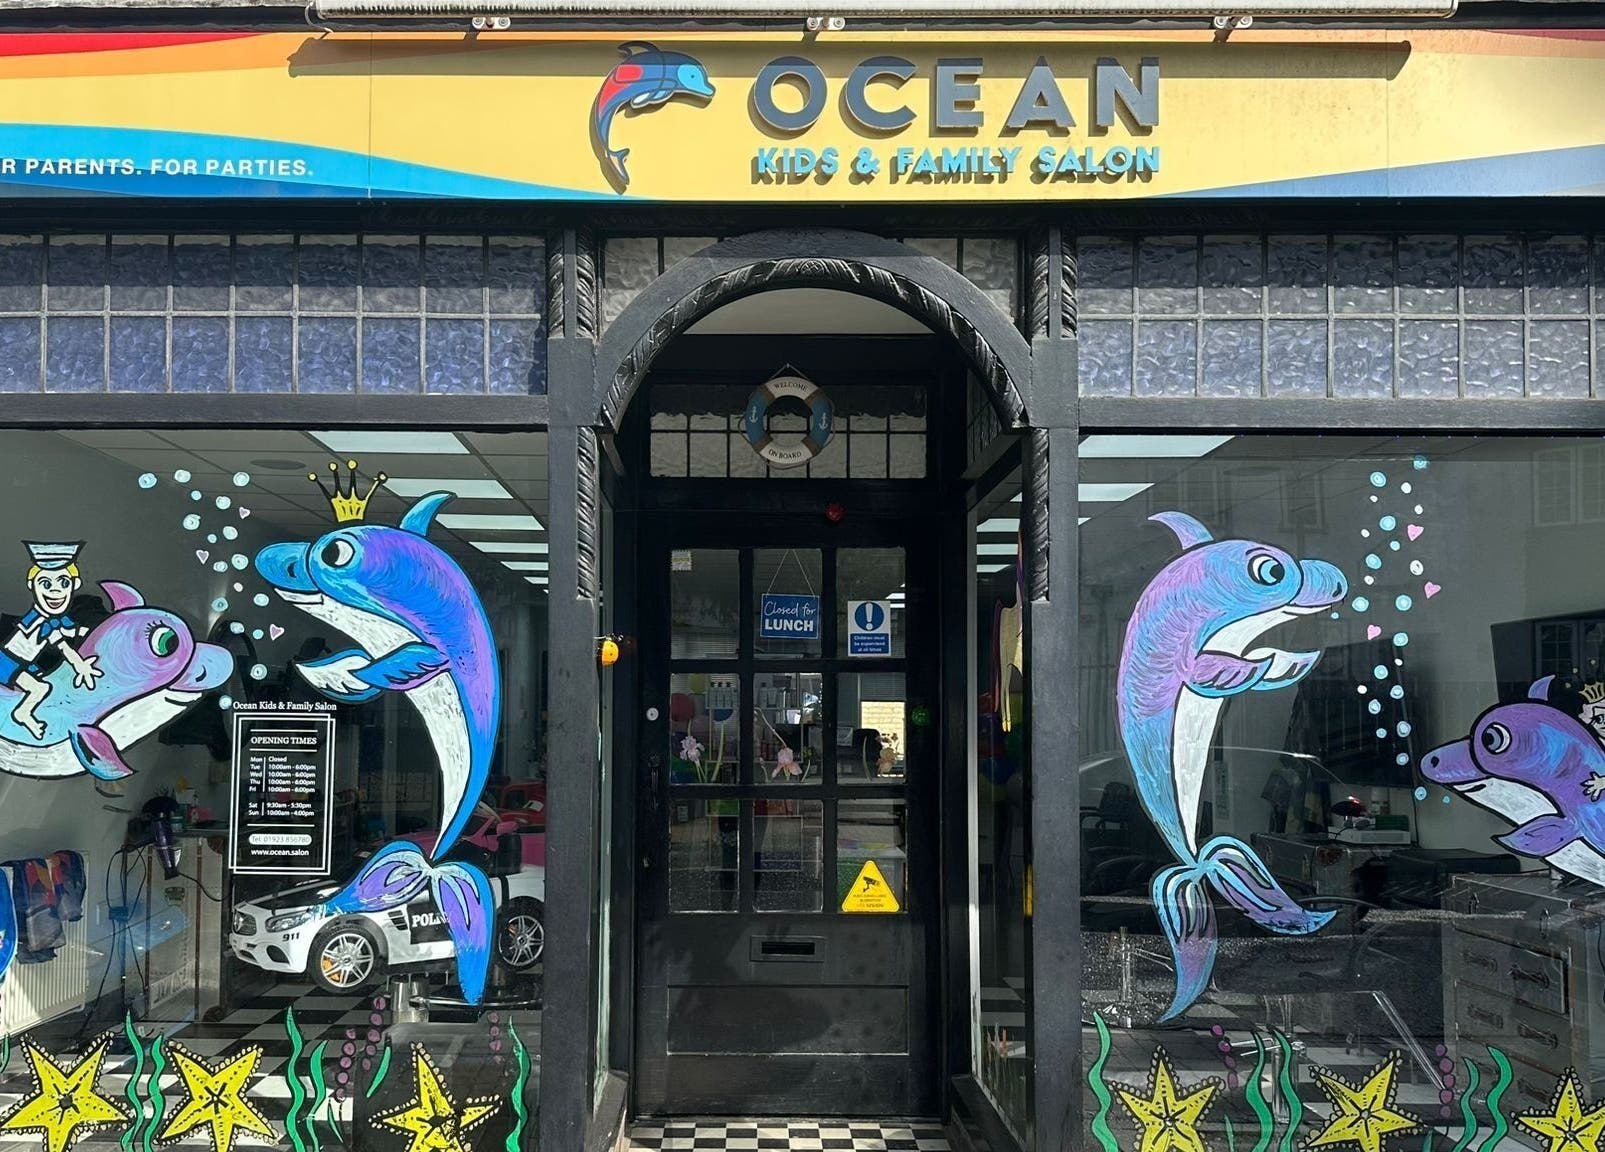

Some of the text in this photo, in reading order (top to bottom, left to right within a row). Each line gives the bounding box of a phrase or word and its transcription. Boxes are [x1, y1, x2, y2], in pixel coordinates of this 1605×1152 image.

[752, 55, 1161, 131] OCEAN
[757, 146, 1161, 174] KIDS & FAMILY SALON
[25, 158, 142, 175] PARENTS.
[150, 158, 198, 176] FOR
[205, 159, 314, 176] PARTIES.
[774, 381, 809, 392] WELCOME
[768, 448, 802, 460] ON BOARD
[764, 600, 816, 617] Closed for
[764, 618, 814, 632] LUNCH
[232, 701, 337, 712] Ocean Kids & Family Salon
[250, 736, 317, 745] OPENING TIMES
[282, 932, 300, 942] 911
